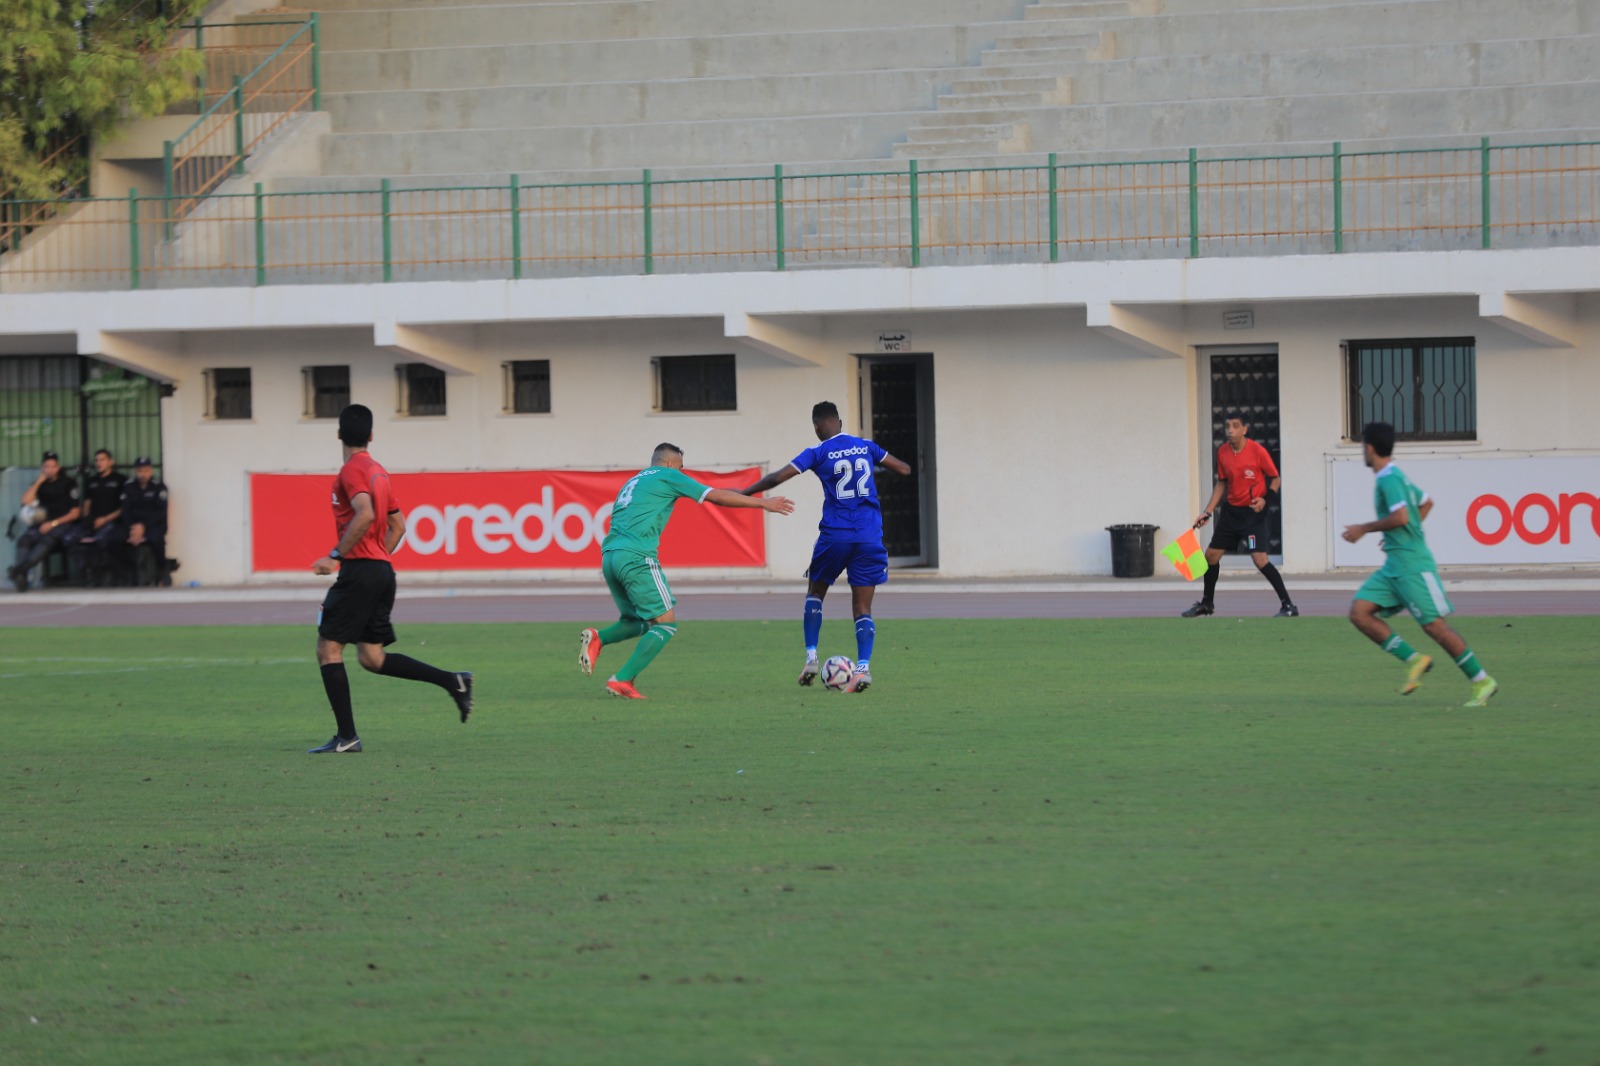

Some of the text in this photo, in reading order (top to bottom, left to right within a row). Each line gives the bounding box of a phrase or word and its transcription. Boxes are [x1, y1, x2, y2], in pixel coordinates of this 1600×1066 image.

[884, 342, 901, 351] WC
[827, 445, 869, 460] ooredoo
[616, 478, 640, 508] 4
[833, 457, 872, 500] 22
[390, 485, 613, 555] oredo
[1466, 492, 1600, 546] oor
